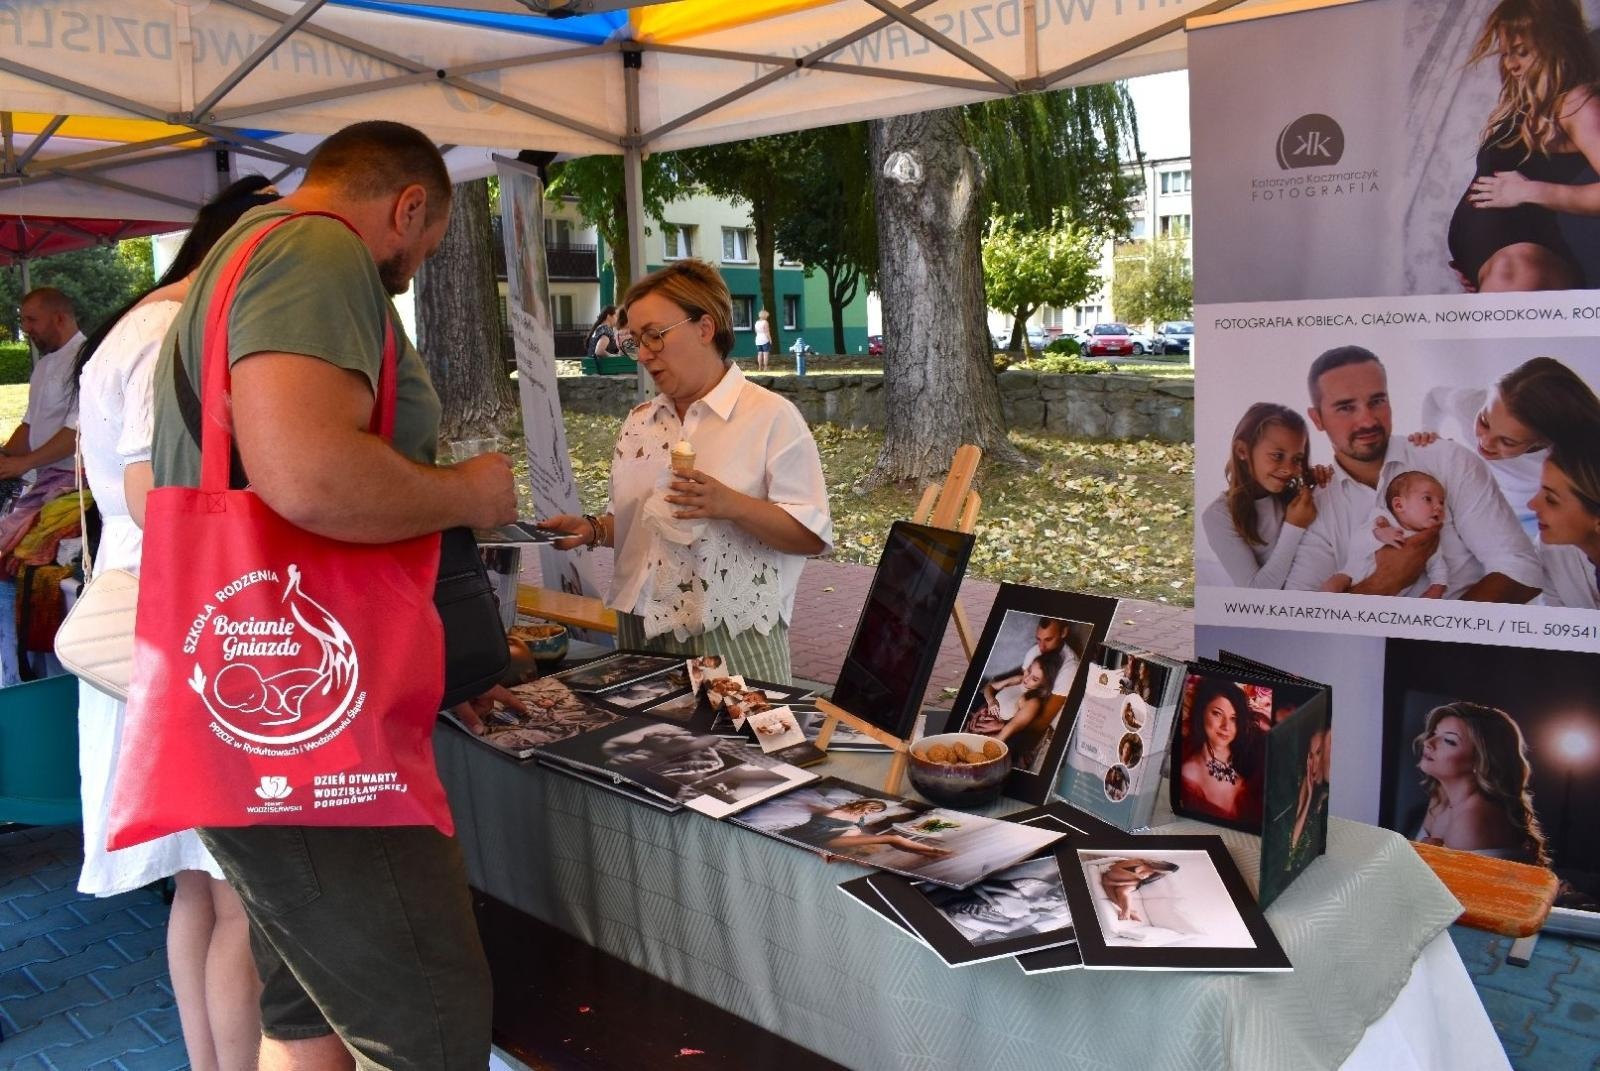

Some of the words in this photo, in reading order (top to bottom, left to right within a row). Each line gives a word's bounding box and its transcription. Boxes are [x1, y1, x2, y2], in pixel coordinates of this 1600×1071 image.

[1252, 174, 1304, 189] Katarzyna
[1306, 167, 1379, 185] Kaczmarczyk
[1252, 181, 1380, 202] FOTOGRAFIA
[1215, 316, 1294, 330] FOTOGRAFIA
[1297, 314, 1358, 327] KOBIECA,
[1435, 308, 1567, 323] NOWORODKOWA,
[183, 604, 216, 654] SZKOŁA
[214, 570, 279, 602] RODZENIA
[1224, 602, 1494, 632] WWW.KATARZYNA-KACZMARCZYK.PL
[1498, 619, 1506, 633] /
[1511, 620, 1538, 635] TEL.
[1543, 623, 1598, 639] 509541
[212, 615, 295, 636] Bocianie
[222, 636, 302, 661] Gniazdo
[209, 721, 235, 744] PPZOZ
[233, 741, 242, 749] w
[243, 742, 299, 757] Rydułtowach
[305, 716, 352, 751] Wodzisławiu
[314, 772, 345, 786] DZIEŃ
[349, 773, 397, 785] OTWARTY
[314, 784, 407, 798] WODZISŁAWSKIEJ
[314, 794, 377, 809] PORODÓWKI
